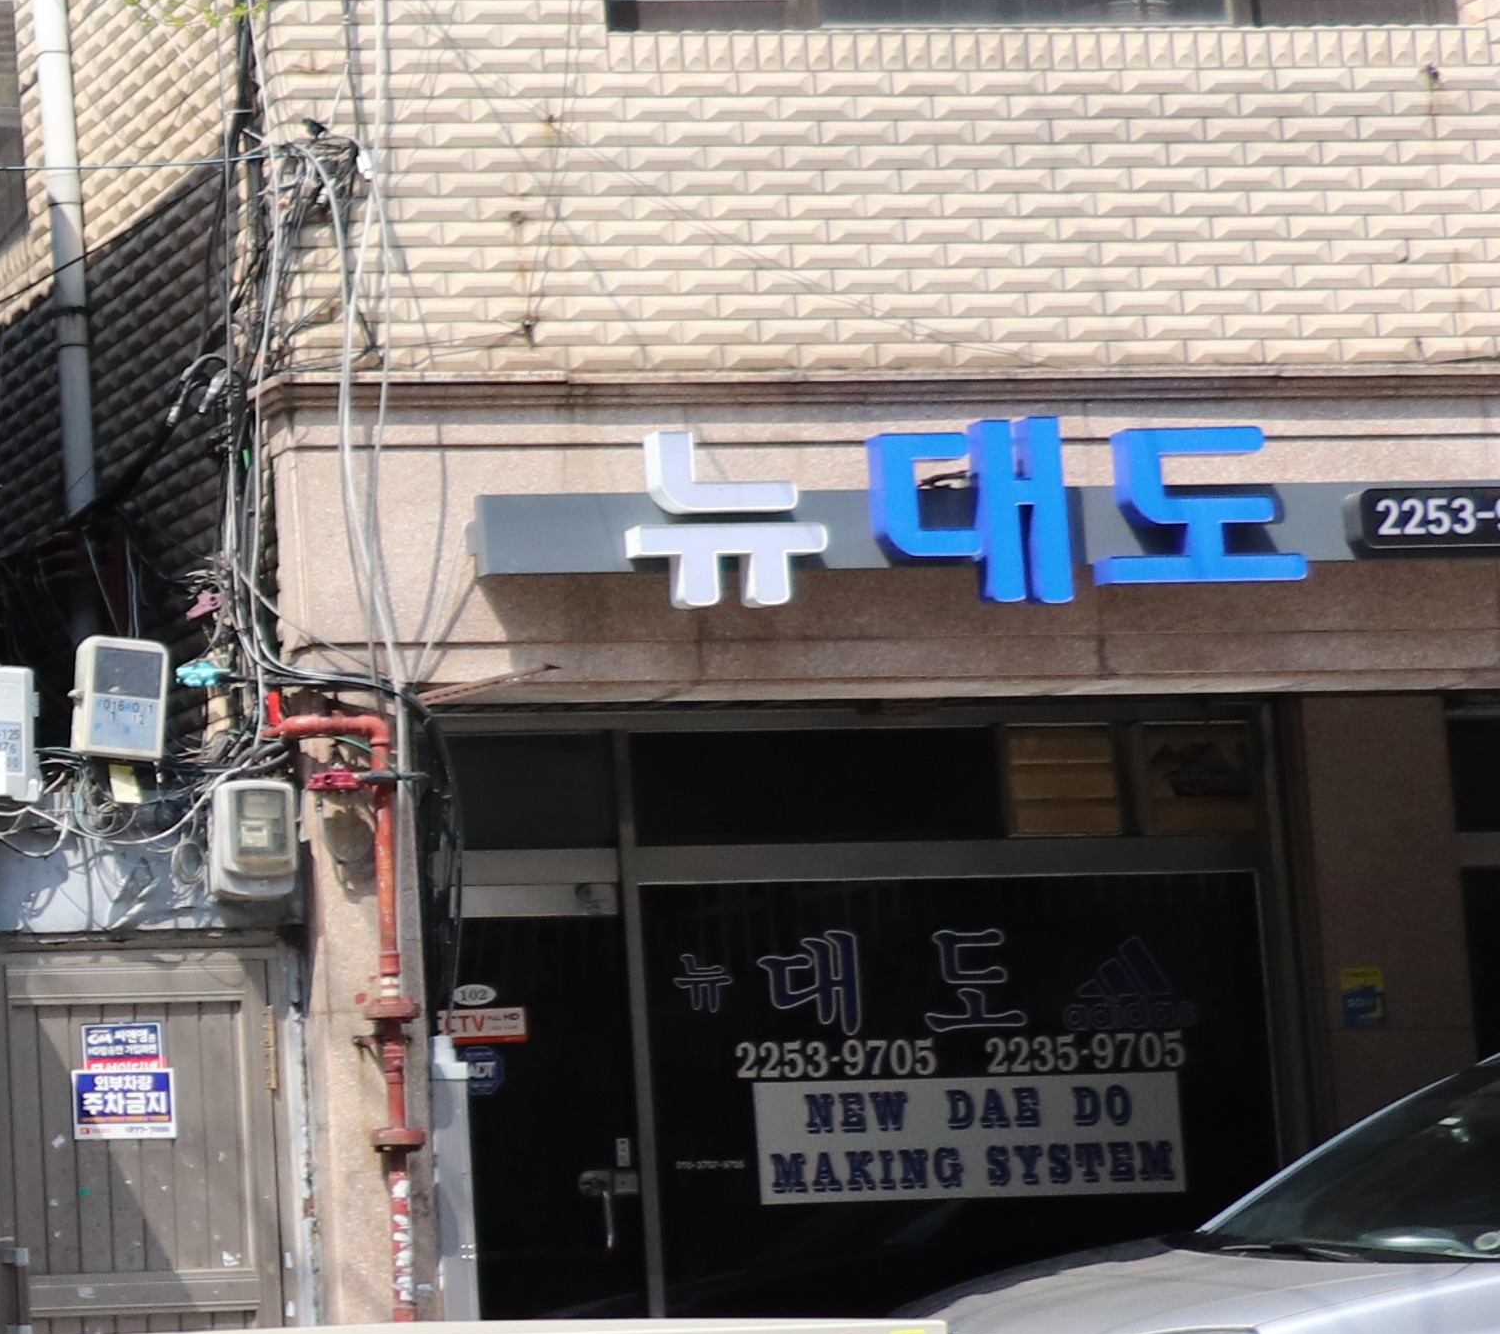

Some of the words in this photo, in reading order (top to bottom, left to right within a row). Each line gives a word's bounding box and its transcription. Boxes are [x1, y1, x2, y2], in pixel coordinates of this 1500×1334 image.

[625, 430, 828, 610] 뉴
[1375, 497, 1500, 536] 2253-
[460, 989, 488, 1001] 102
[673, 954, 734, 1013] 뉴
[1061, 998, 1198, 1031] adidas
[735, 1038, 937, 1079] 2253-9705
[984, 1030, 1186, 1074] 2235-9705
[82, 1091, 168, 1116] 주차금지
[93, 1074, 154, 1091] 외부차량
[805, 1089, 909, 1135] NEW
[945, 1086, 1042, 1131] DAE
[1072, 1083, 1134, 1127] DO
[770, 1146, 965, 1194] MAKING
[985, 1139, 1177, 1187] SYSTEM
